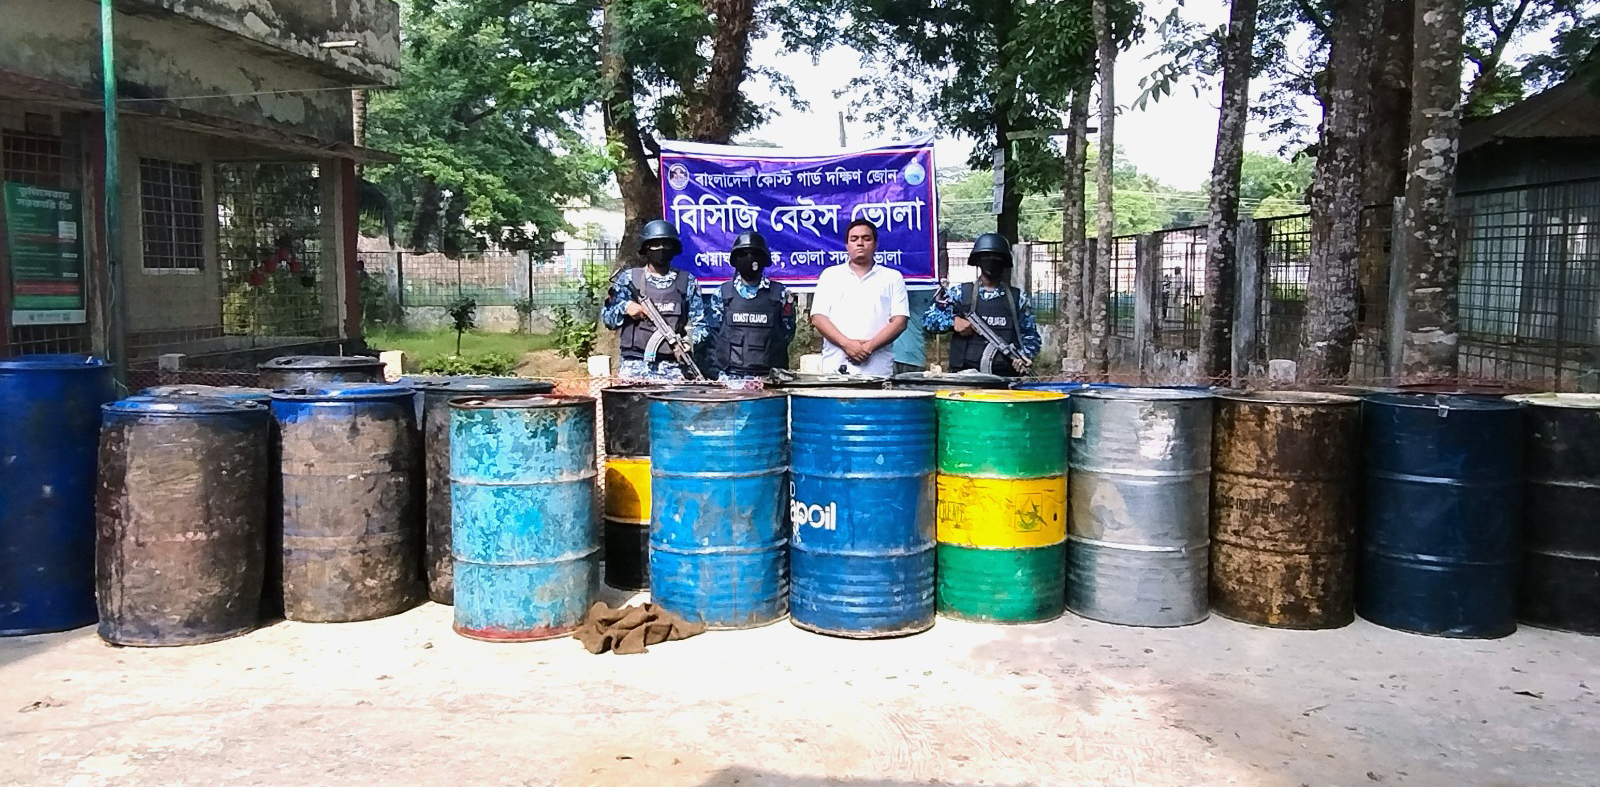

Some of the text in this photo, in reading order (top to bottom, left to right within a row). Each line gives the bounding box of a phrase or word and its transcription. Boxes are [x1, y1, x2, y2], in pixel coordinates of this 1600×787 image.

[694, 166, 898, 189] বাংলাদেশ কোস্ট গার্ড দক্ষিণ জোন
[670, 194, 926, 237] বিসিজি বেইস ভোলা
[694, 251, 731, 267] খেয়াঘ
[790, 250, 825, 266] ভোলা
[829, 250, 850, 265] সদ
[732, 313, 767, 324] COAST GUARD
